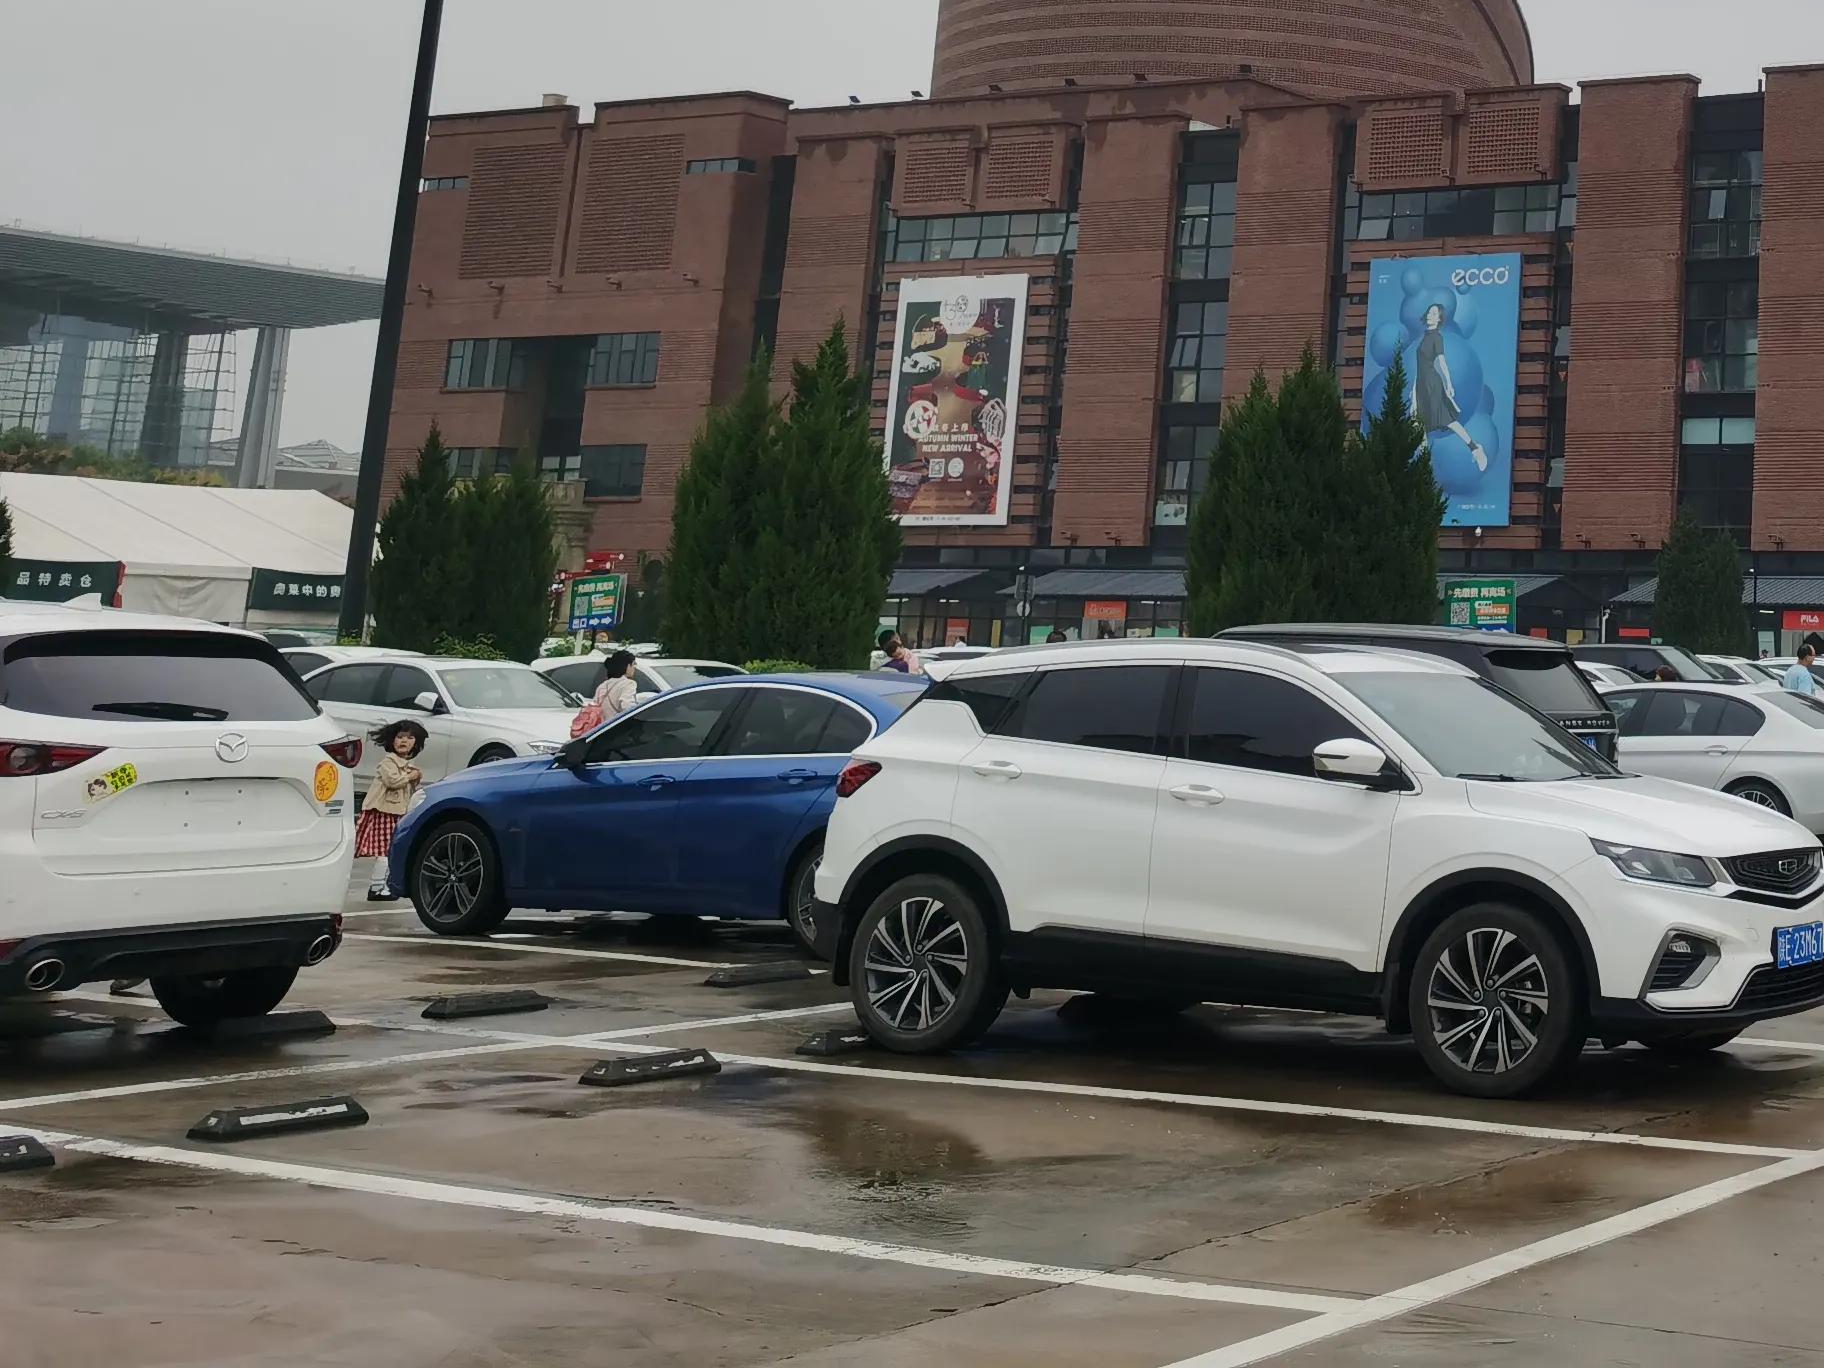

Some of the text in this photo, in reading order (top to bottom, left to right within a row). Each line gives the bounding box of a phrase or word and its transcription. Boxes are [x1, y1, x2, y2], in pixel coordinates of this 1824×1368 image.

[1451, 267, 1509, 286] ecco
[921, 443, 973, 453] NEW ARRIVAL
[1800, 614, 1820, 624] FILA
